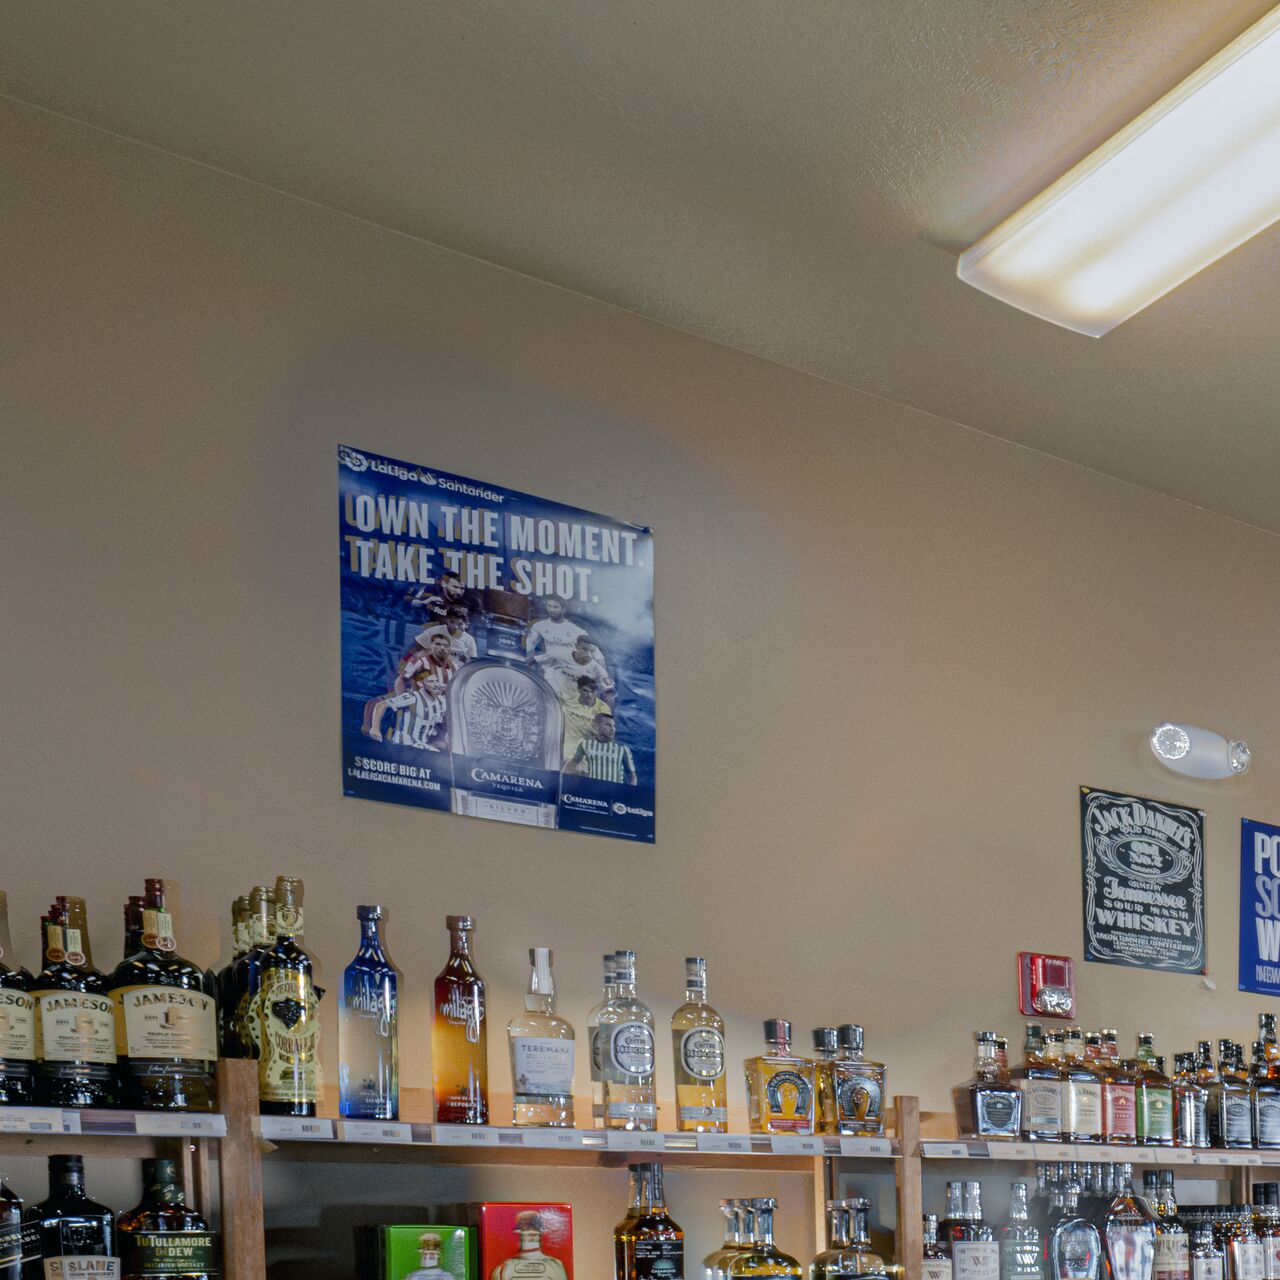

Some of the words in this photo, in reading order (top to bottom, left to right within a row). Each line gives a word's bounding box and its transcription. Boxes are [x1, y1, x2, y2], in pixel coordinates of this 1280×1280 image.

[371, 461, 418, 482] LaLiga
[439, 478, 504, 503] Santander
[355, 494, 429, 539] OWN
[441, 505, 499, 547] THE
[511, 515, 644, 567] MOMENT.
[356, 540, 435, 584] TAKE
[446, 551, 504, 591] THE
[516, 560, 598, 603] SHOT.
[362, 758, 397, 774] SCORE
[399, 764, 417, 778] BIG
[418, 768, 432, 779] AT
[471, 768, 544, 789] CAMARENA
[493, 782, 523, 793] TEQUILA
[563, 793, 609, 808] CAMARENA
[1093, 806, 1133, 835] JACK
[1095, 908, 1195, 938] WHISKEY
[1256, 964, 1280, 984] NEW
[133, 991, 209, 1011] JAMESN
[149, 1235, 212, 1247] TULLAMORE
